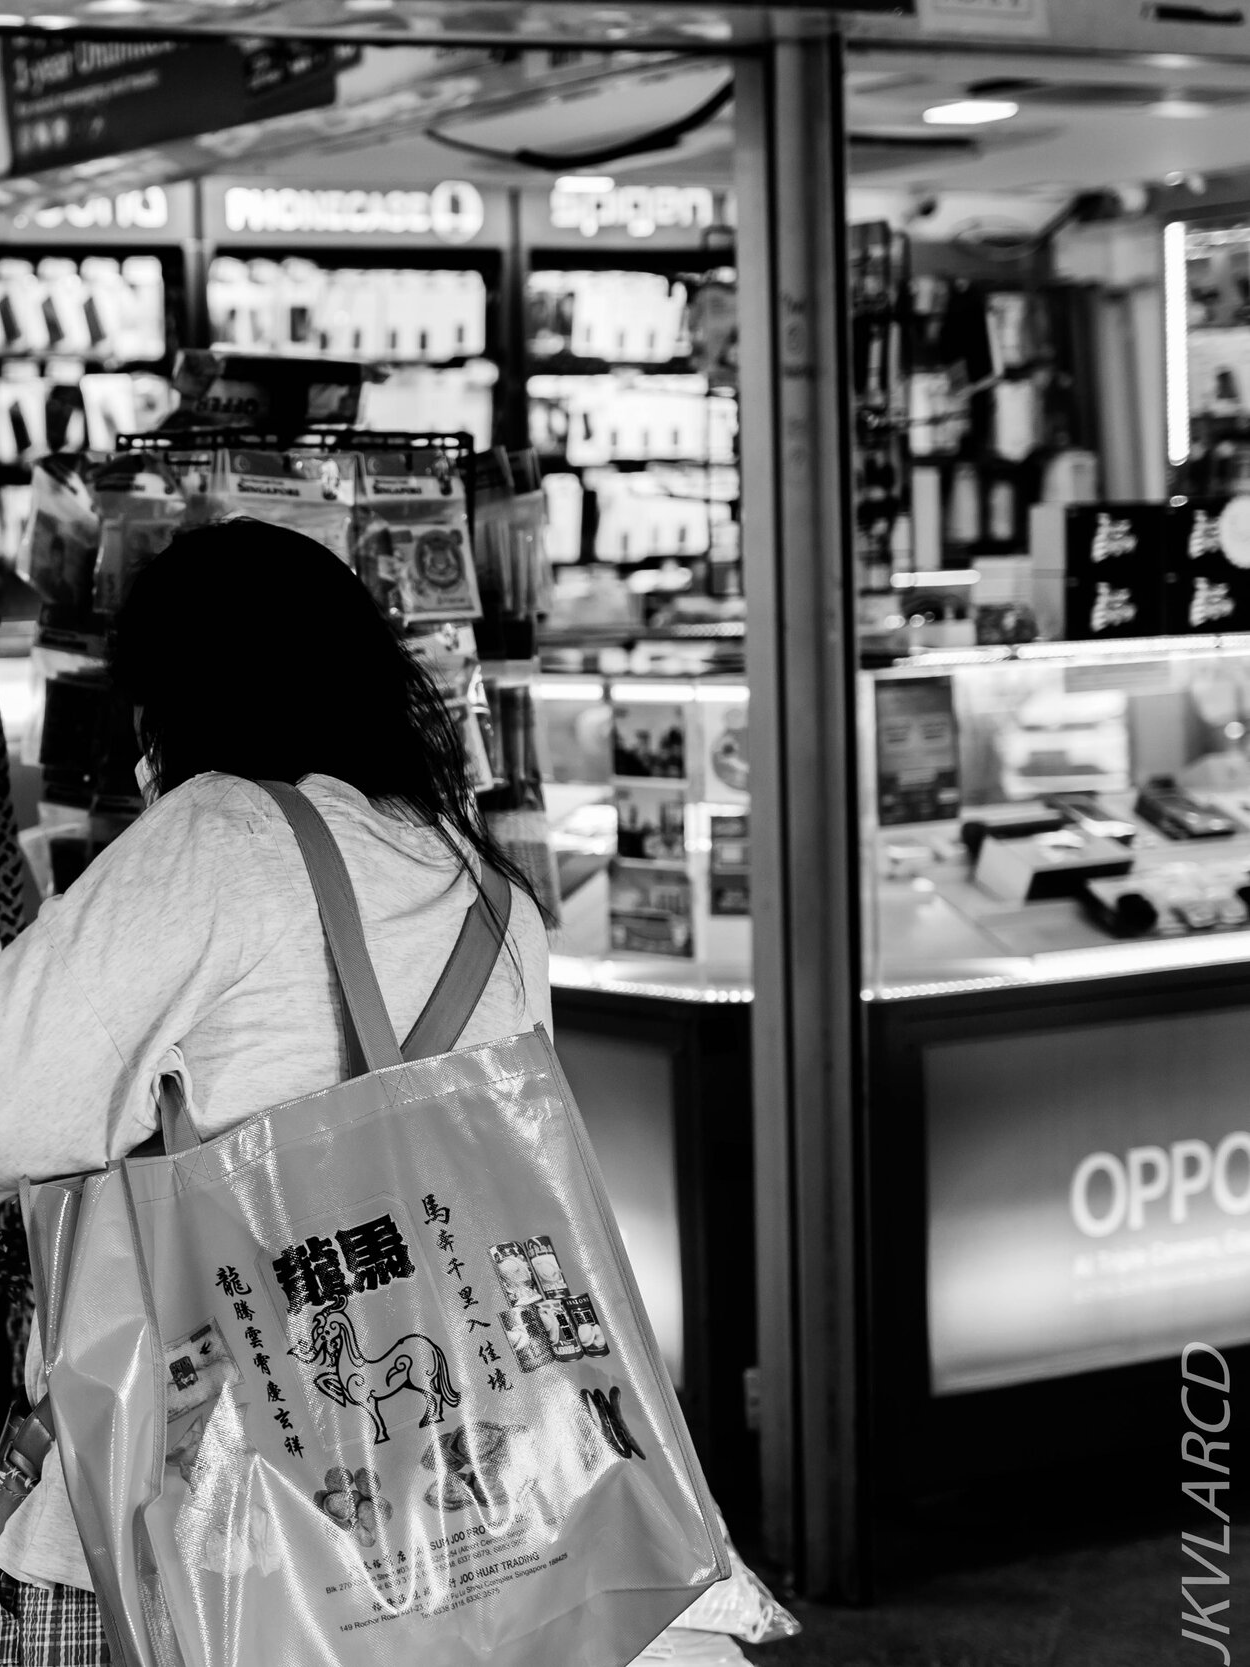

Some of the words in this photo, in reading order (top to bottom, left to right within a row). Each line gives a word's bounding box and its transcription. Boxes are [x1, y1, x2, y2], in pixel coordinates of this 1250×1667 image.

[1069, 1131, 1250, 1239] OPPO
[450, 1531, 465, 1544] JOO
[459, 1571, 474, 1585] JOO
[500, 1551, 540, 1571] TRADING
[326, 1585, 338, 1595] Blk
[340, 1623, 353, 1633] 149
[514, 1564, 547, 1581] Singapore
